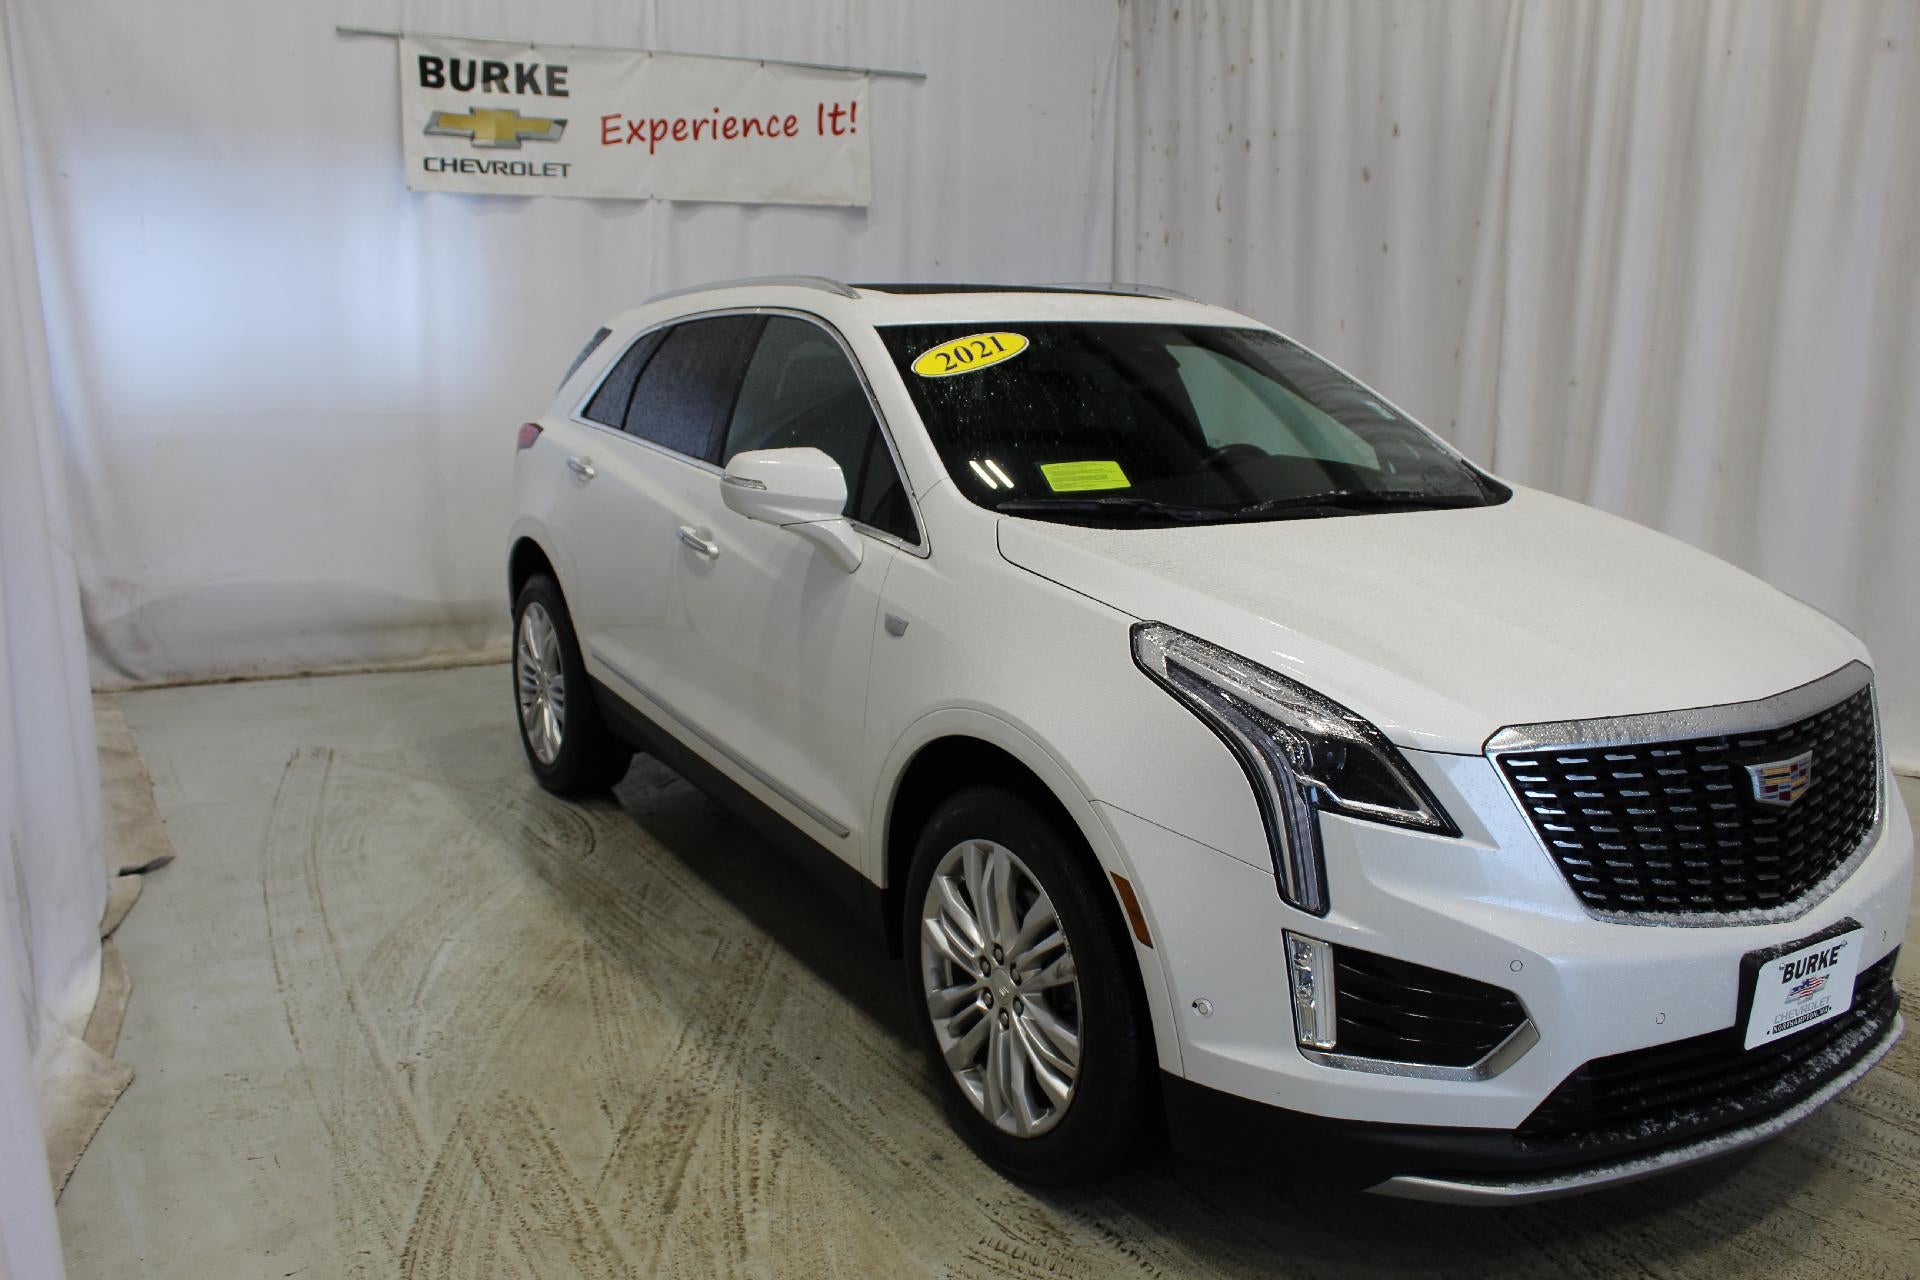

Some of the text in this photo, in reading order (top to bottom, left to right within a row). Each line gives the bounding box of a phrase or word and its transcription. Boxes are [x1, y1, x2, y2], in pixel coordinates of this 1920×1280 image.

[418, 54, 570, 97] BURKE
[600, 101, 858, 154] Experience It!
[423, 156, 571, 178] CHEVROLET
[935, 335, 1008, 372] 2021
[1782, 945, 1841, 984] BURKE
[1775, 995, 1831, 1023] CHEVROLET
